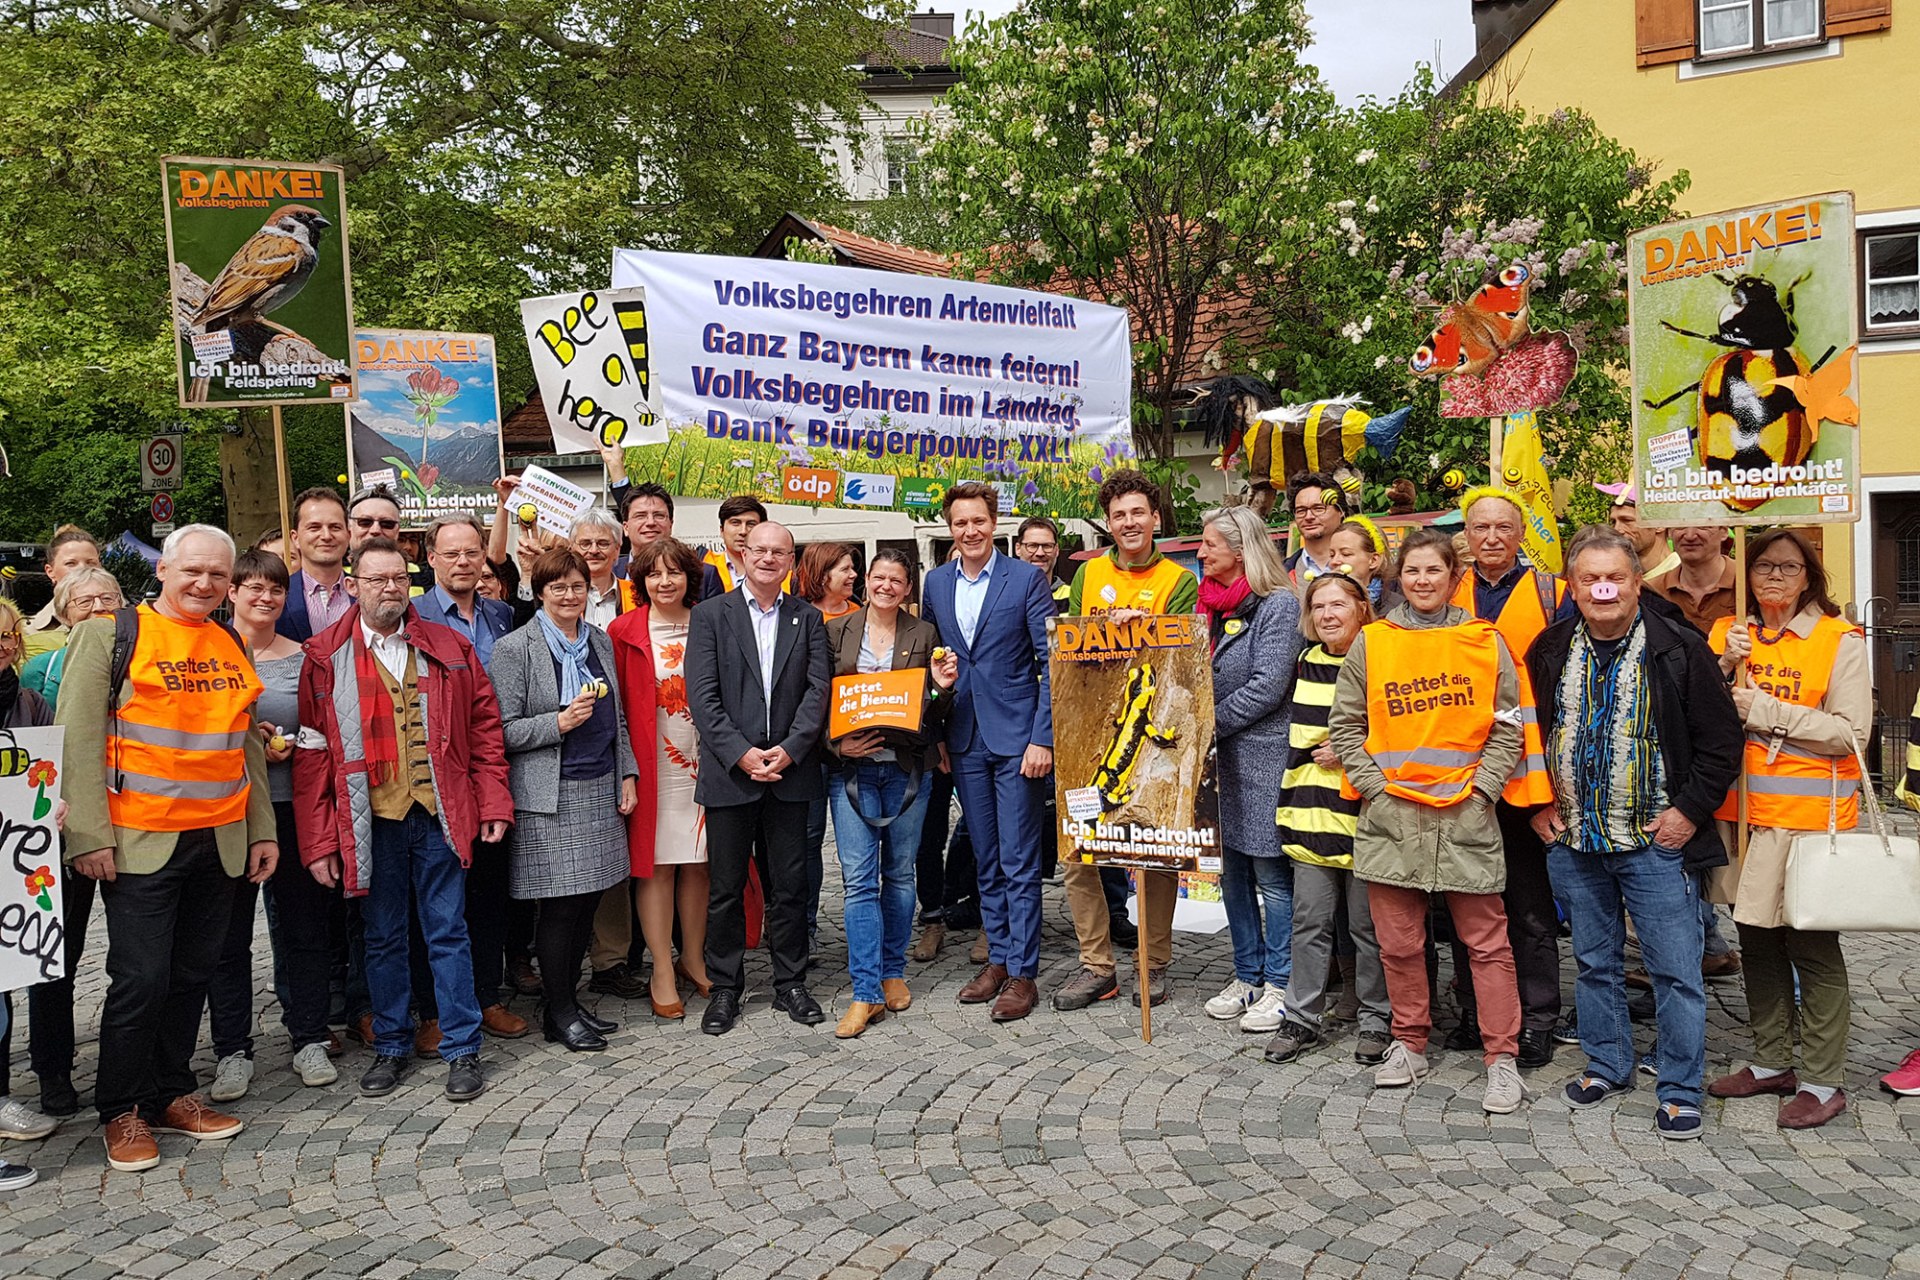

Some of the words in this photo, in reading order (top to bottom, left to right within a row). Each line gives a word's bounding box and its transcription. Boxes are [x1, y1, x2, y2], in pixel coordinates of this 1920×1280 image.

[179, 170, 324, 199] DANKE!
[176, 197, 270, 209] Volksbegehren
[1645, 202, 1821, 274] DANKE!
[1640, 255, 1745, 286] Volksbegehren
[714, 280, 932, 319] Volksbegehren
[939, 293, 1077, 330] Artenvielfalt
[193, 333, 219, 342] STOPPT
[535, 291, 609, 369] Bee
[357, 340, 478, 363] DANKE!
[703, 322, 788, 359] Ganz
[799, 331, 911, 371] Bayern
[921, 345, 993, 378] kann
[1000, 352, 1080, 388] feiern!
[189, 361, 223, 377] Ich
[228, 361, 260, 377] bin
[265, 359, 345, 377] bedroht!
[225, 376, 316, 389] Feldsperling
[691, 366, 930, 414] Volksbegehren
[939, 386, 974, 417] im
[982, 391, 1082, 432] Landtag.
[558, 379, 628, 447] hero
[707, 410, 796, 445] Dank
[807, 418, 1009, 462] Bürgerpower
[1018, 434, 1073, 464] XXL!
[1650, 433, 1676, 446] STOPPT
[153, 449, 170, 466] 30
[152, 478, 172, 487] ZONE
[1645, 470, 1679, 488] Ich
[1685, 467, 1723, 486] bin
[1731, 458, 1843, 485] bedroht!
[788, 474, 832, 498] ödp
[871, 485, 892, 494] LBV
[1644, 482, 1848, 503] Heidekraut-Marienkäfer
[426, 493, 498, 508] bedroht!
[399, 507, 476, 519] urpurenzian
[1057, 616, 1192, 650] DANKE!
[156, 657, 220, 674] Rettet
[223, 661, 239, 672] die
[1055, 650, 1138, 662] Volksbegehren
[162, 673, 248, 692] Bienen!
[1778, 667, 1802, 679] die
[839, 682, 882, 699] Rettet
[1384, 672, 1448, 698] Rettet
[1451, 674, 1471, 685] die
[839, 699, 857, 713] die
[861, 691, 908, 708] Bienen!
[1387, 686, 1475, 717] Bienen!
[1062, 818, 1090, 836] Ich
[1096, 822, 1125, 840] bin
[1130, 823, 1214, 846] bedroht!
[1074, 835, 1202, 858] Feuersalamander
